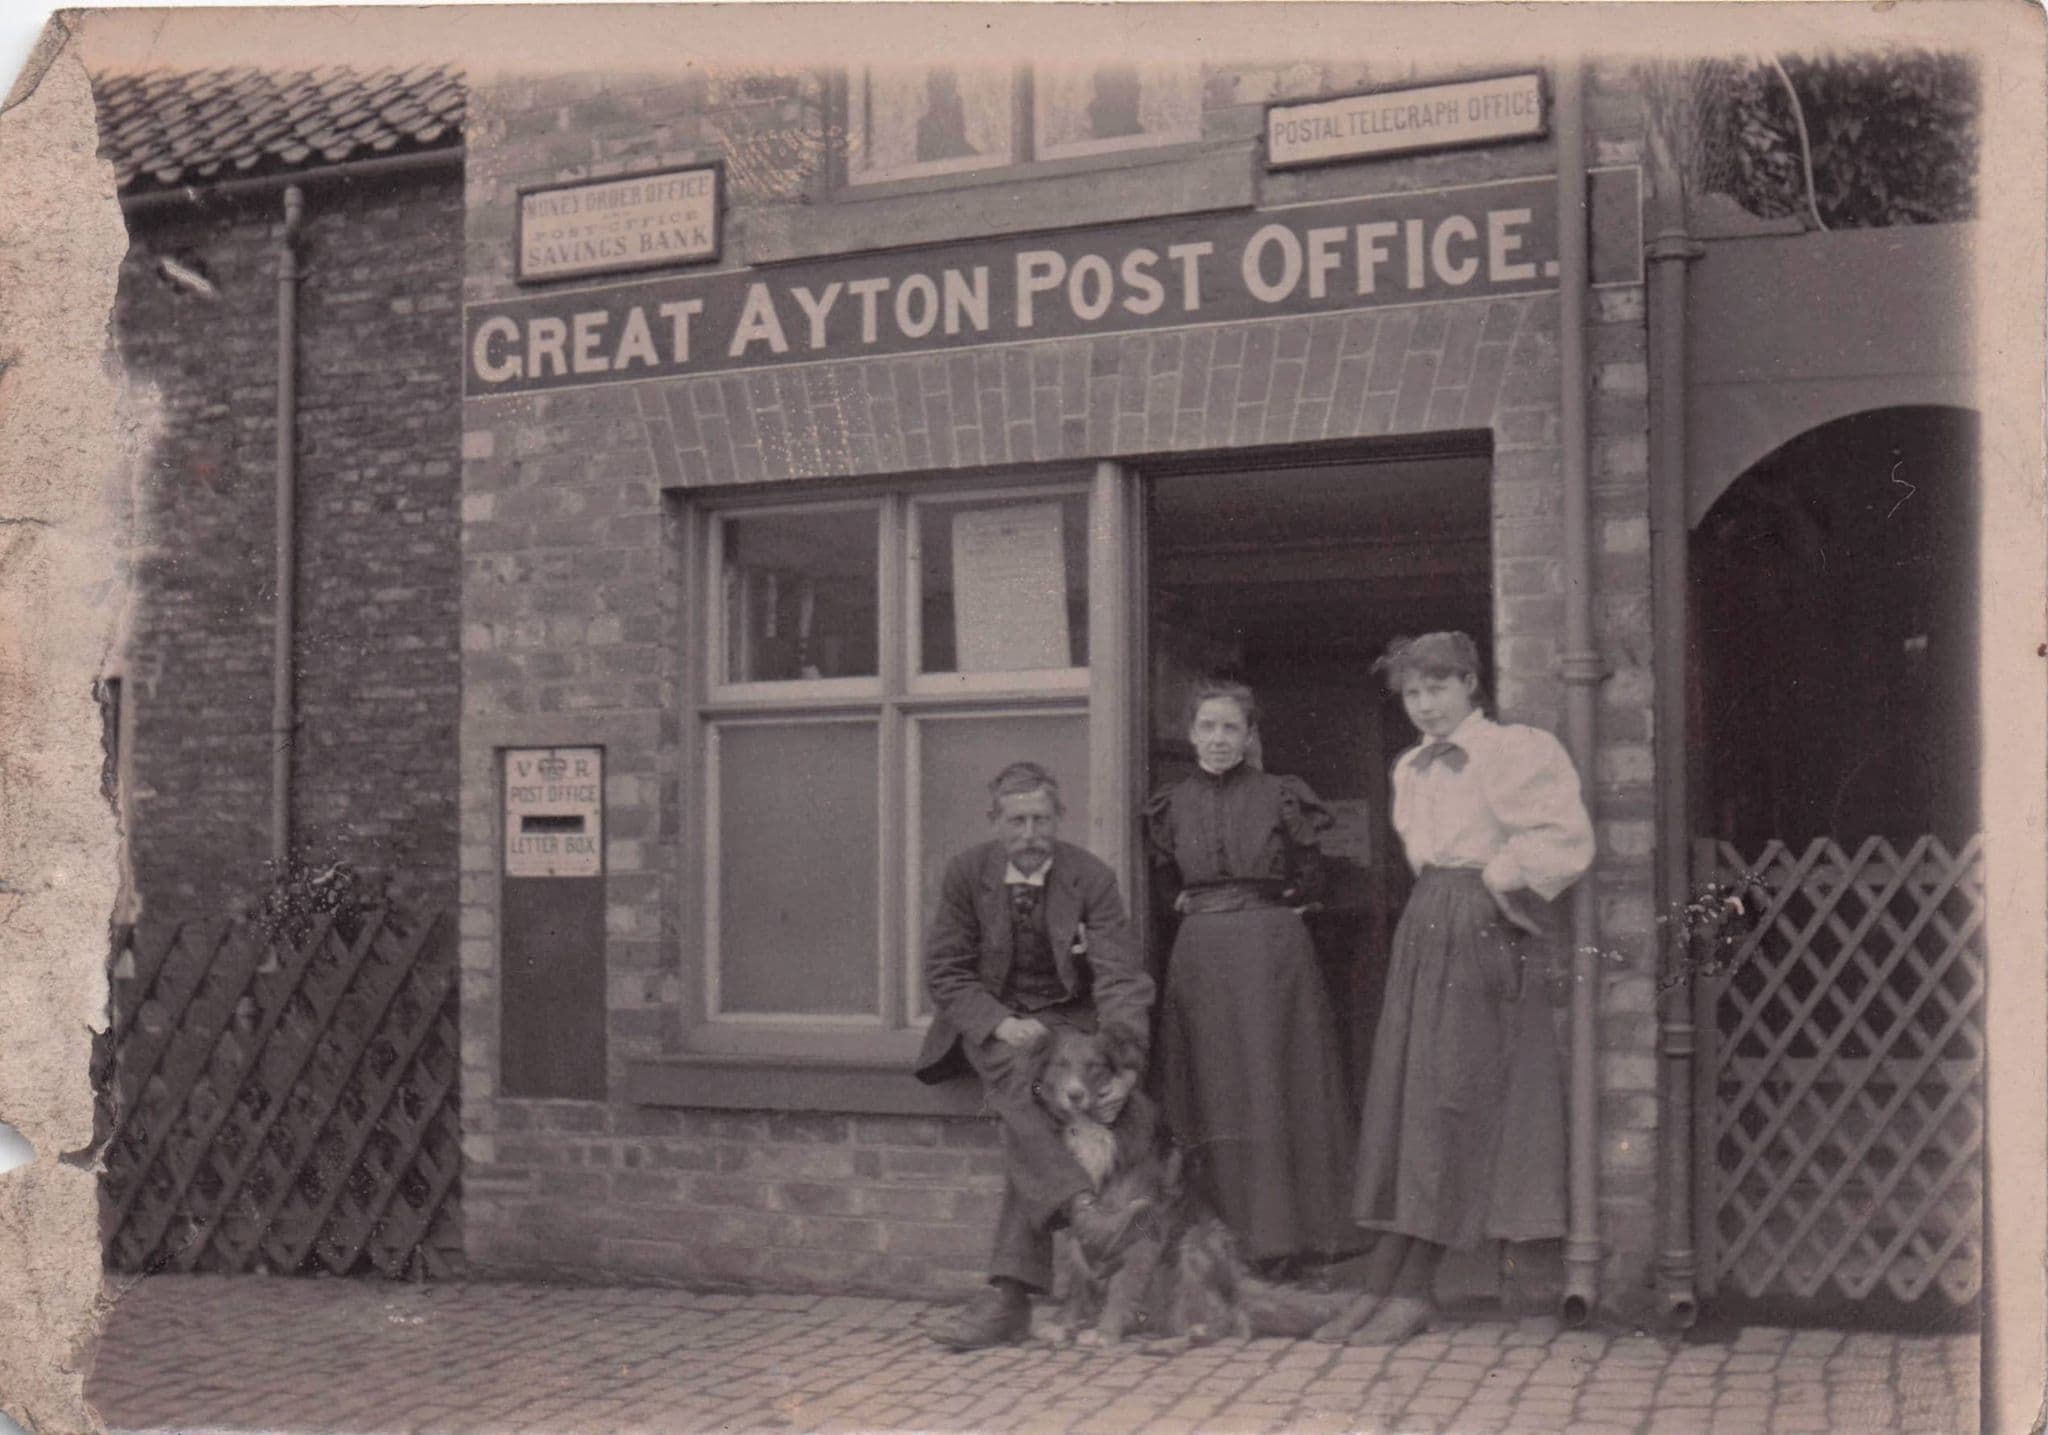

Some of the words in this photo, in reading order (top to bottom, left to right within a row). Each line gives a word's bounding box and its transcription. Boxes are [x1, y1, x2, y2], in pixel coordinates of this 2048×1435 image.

[1274, 117, 1345, 146] POSTAL
[1347, 99, 1459, 136] TELEGRAPH
[1467, 89, 1538, 122] OFFICE
[525, 194, 580, 220] MONEY
[585, 185, 642, 212] ORDER
[645, 175, 711, 204] OFFICE
[534, 223, 598, 241] POST
[608, 209, 699, 233] OFFICE
[527, 235, 628, 268] SAVINGS
[639, 223, 708, 254] BANK
[472, 299, 703, 384] GREAT
[728, 266, 990, 358] AYTON
[1016, 241, 1214, 328] POST
[1241, 208, 1560, 302] OFFICE.
[516, 760, 532, 778] V
[575, 759, 592, 777] R
[510, 785, 544, 803] POST
[547, 784, 597, 803] OFFICE
[511, 836, 558, 854] LETTER
[565, 836, 596, 854] BOX
